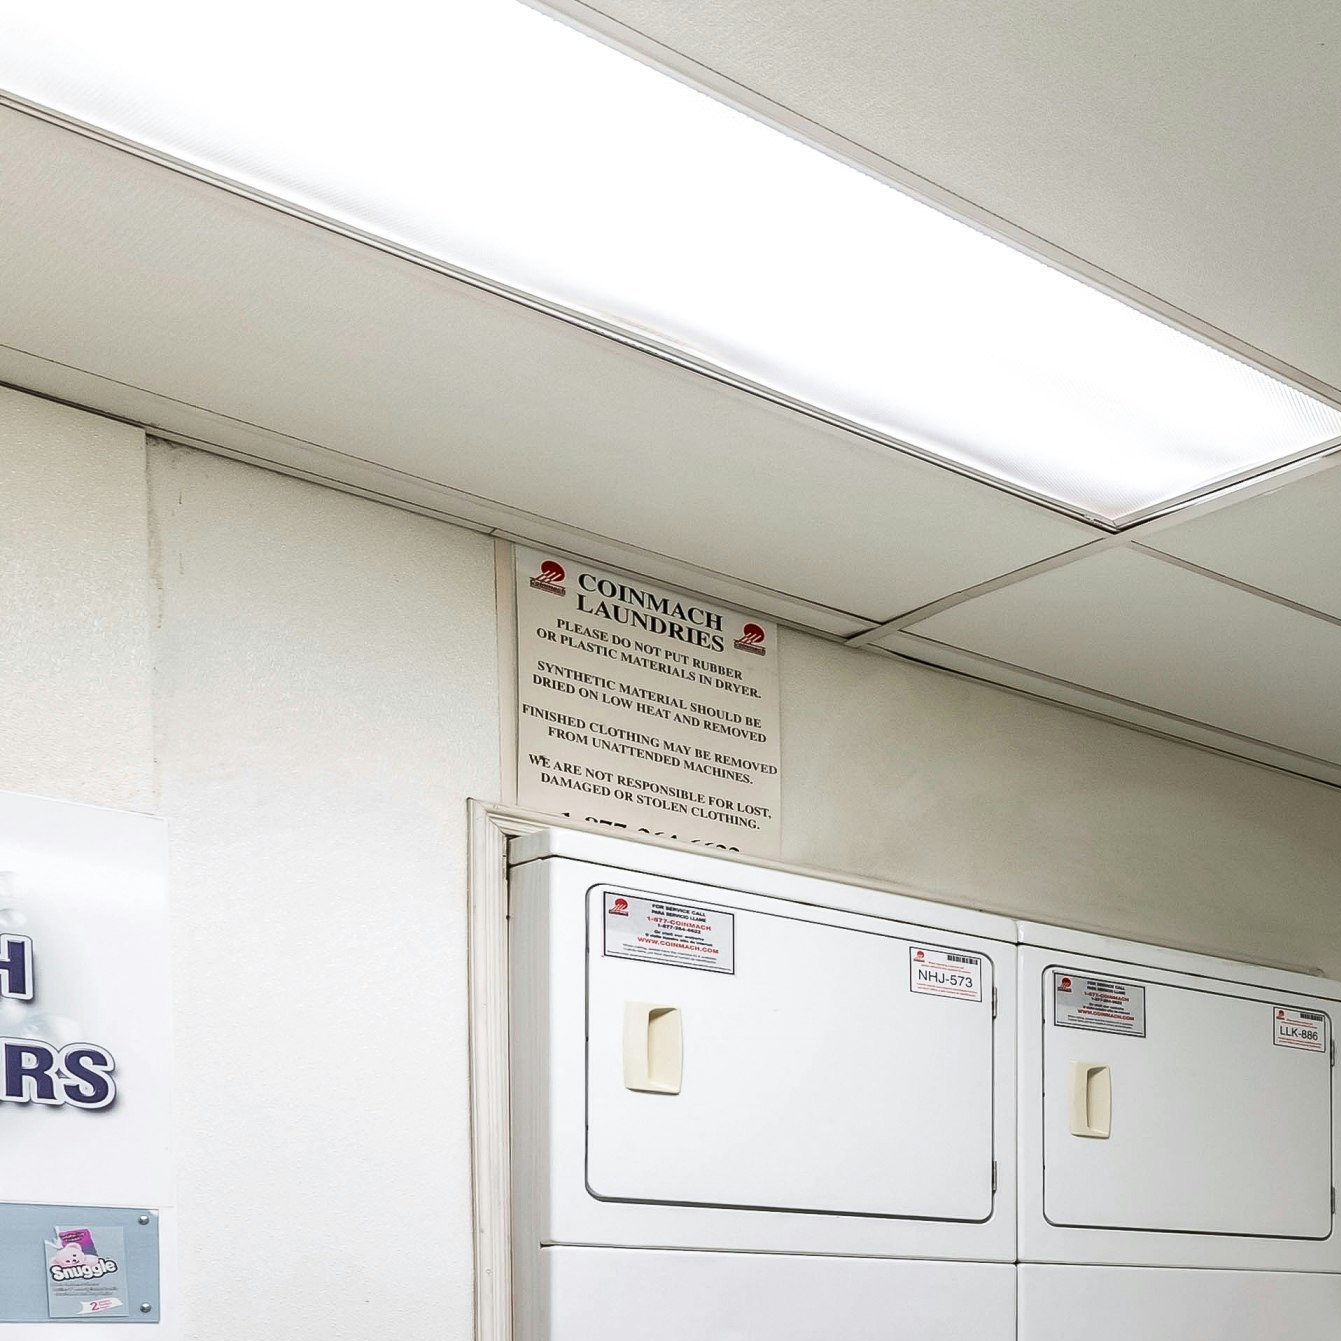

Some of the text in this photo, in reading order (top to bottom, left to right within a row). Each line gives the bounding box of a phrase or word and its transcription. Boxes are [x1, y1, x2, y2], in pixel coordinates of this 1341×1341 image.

[576, 593, 724, 652] LAUNDRIES
[578, 573, 723, 631] COINMACH
[536, 627, 762, 699] OR PLASTIC MATERIALS IN DRYER.
[557, 618, 743, 680] PLEASE DO NOT PUT RUBBER
[532, 673, 767, 743] DRIED ON LOW HEAT AND REMOVED
[537, 660, 762, 728] SYNTHETIC MATERIAL SHOULD BE
[522, 703, 778, 775] FINISHED CLOTHING MAY BE REMOVED
[548, 726, 753, 785] FROM UNATTENDED MACHINES.
[529, 754, 772, 819] WE ARE NOT RESPONSIBLE FOR LOST,
[541, 772, 760, 830] DAMAGED OR STOLEN CLOTHING.
[919, 969, 972, 987] NHJ-573
[50, 1257, 118, 1281] Snuggle
